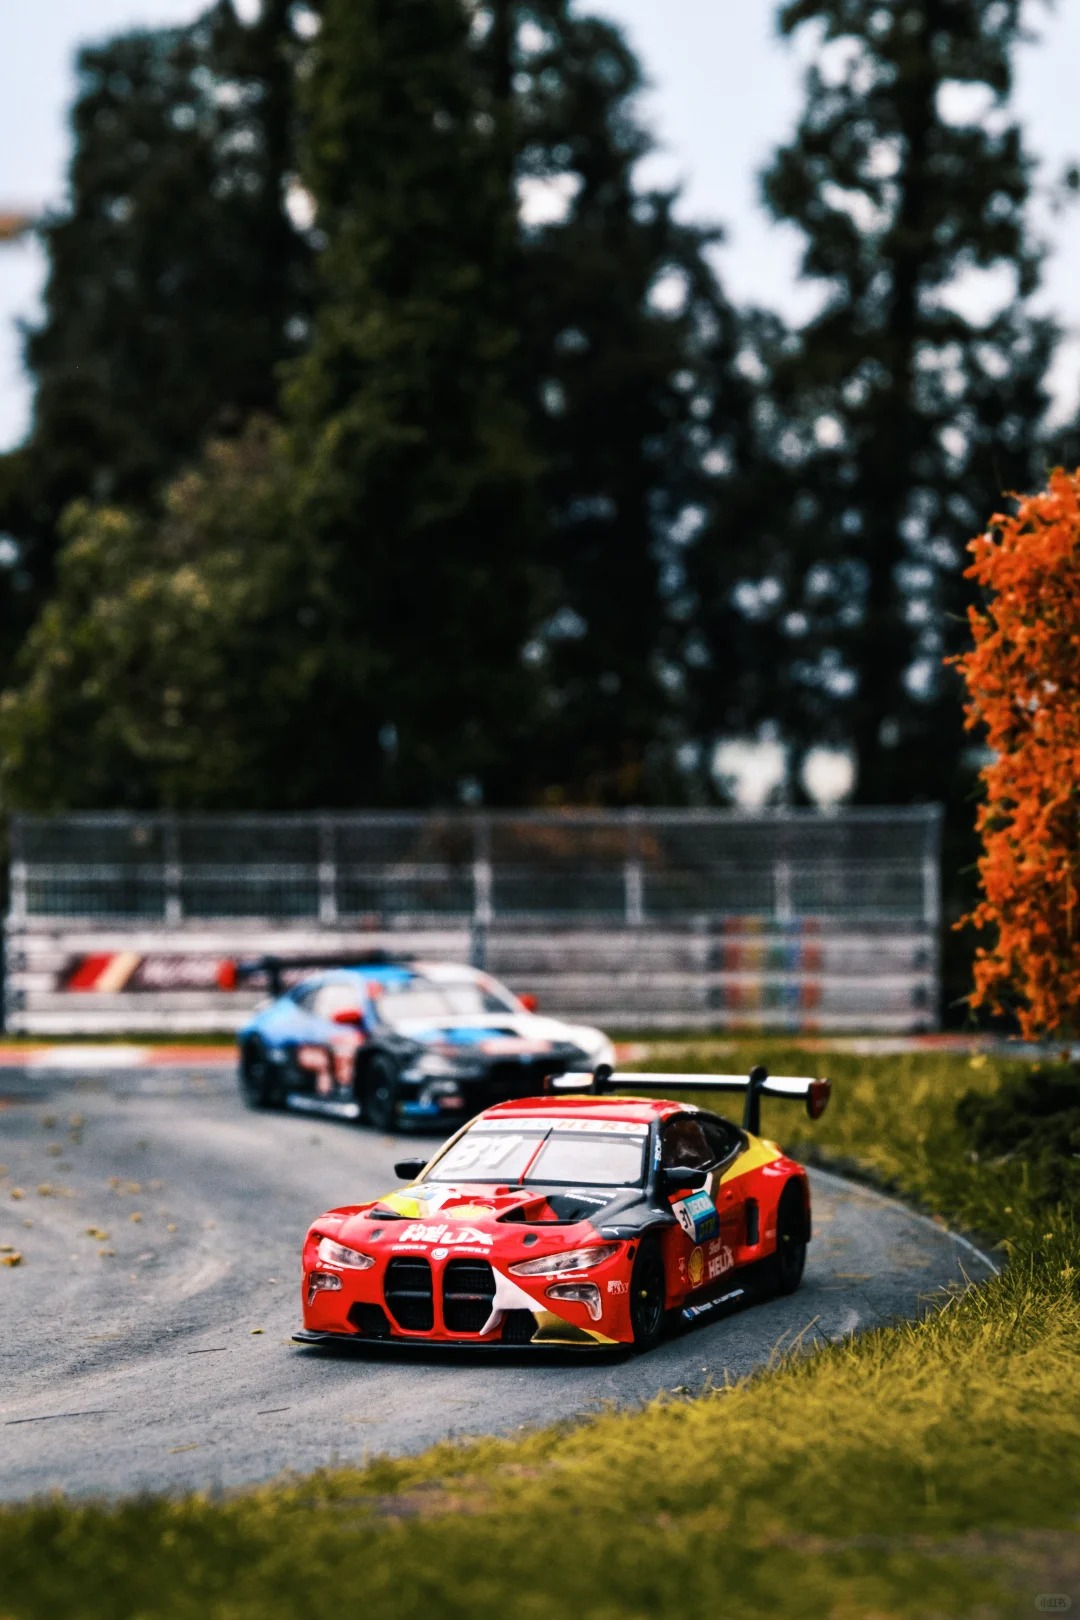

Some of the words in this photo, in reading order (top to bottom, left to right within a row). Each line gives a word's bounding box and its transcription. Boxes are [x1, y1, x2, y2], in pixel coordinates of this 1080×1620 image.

[679, 1208, 692, 1229] 31
[398, 1227, 494, 1246] HELIX
[407, 1223, 449, 1237] Shell
[708, 1245, 734, 1279] HELIX
